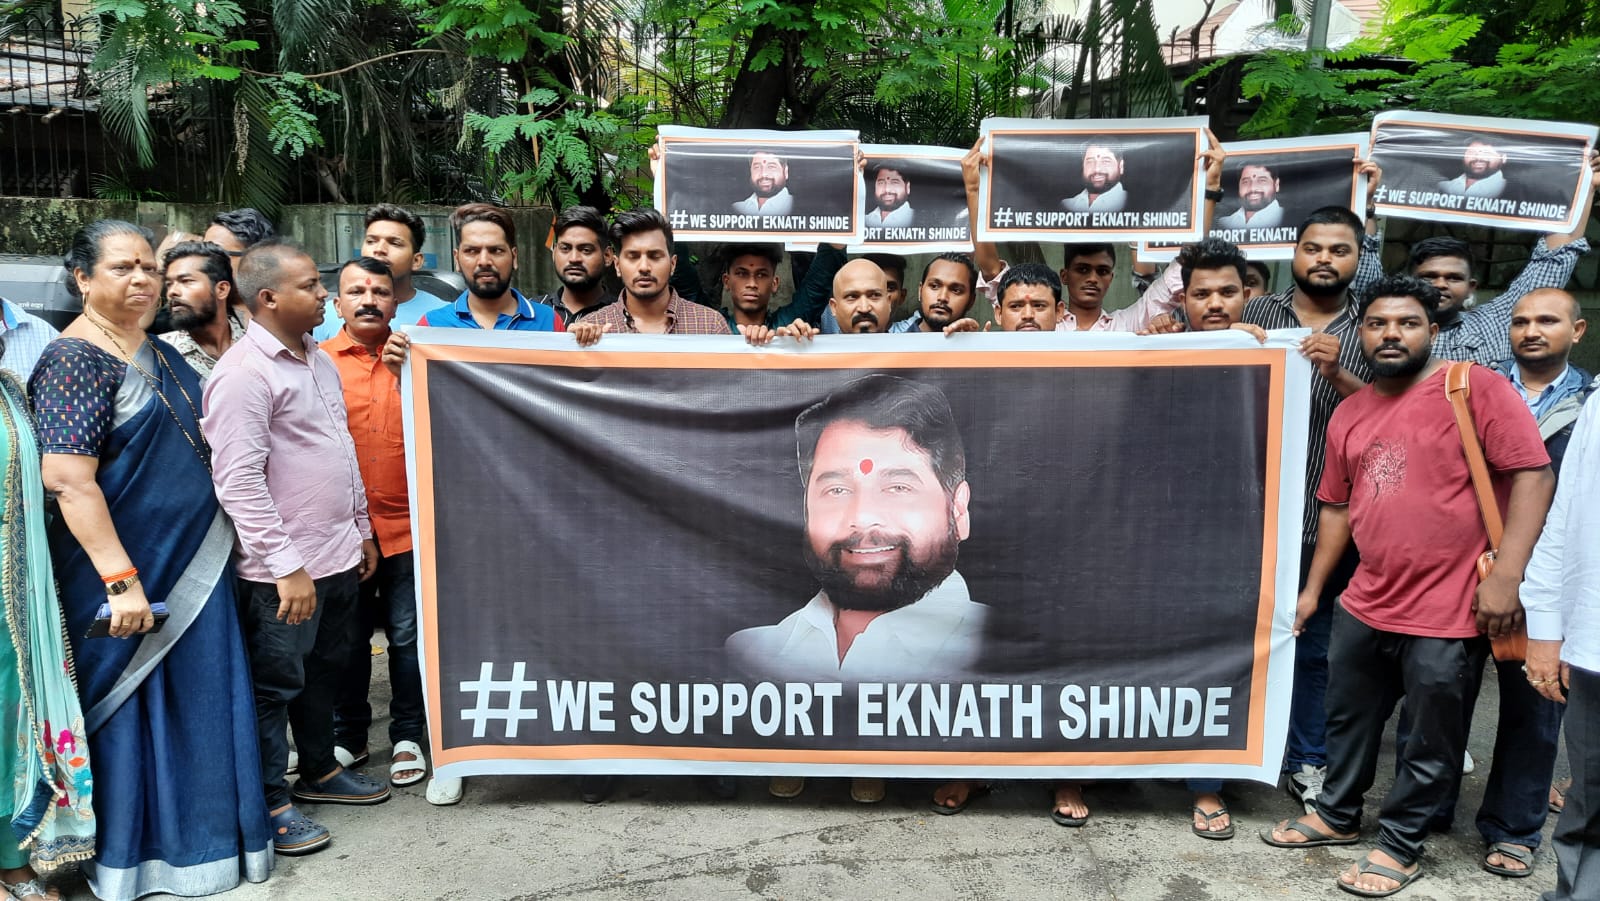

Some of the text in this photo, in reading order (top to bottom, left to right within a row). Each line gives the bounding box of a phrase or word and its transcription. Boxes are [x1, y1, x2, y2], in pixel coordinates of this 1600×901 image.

[1409, 190, 1464, 208] SUPPORT
[1466, 196, 1515, 214] EKNATH
[1518, 202, 1567, 219] SHINDE
[709, 214, 760, 229] SUPPORT
[764, 215, 807, 230] EKNATH
[809, 216, 849, 230] SHINDE
[1035, 212, 1089, 227] SUPPORT
[1092, 211, 1139, 227] EKNATH
[1143, 212, 1187, 227] SHINDE
[884, 227, 926, 240] EKNATH
[928, 227, 967, 240] SHINDE
[1250, 227, 1297, 242] EKNATH
[630, 680, 842, 737] SUPPORT
[857, 682, 1042, 739] EKNATH
[1058, 684, 1232, 740] SHINDE
